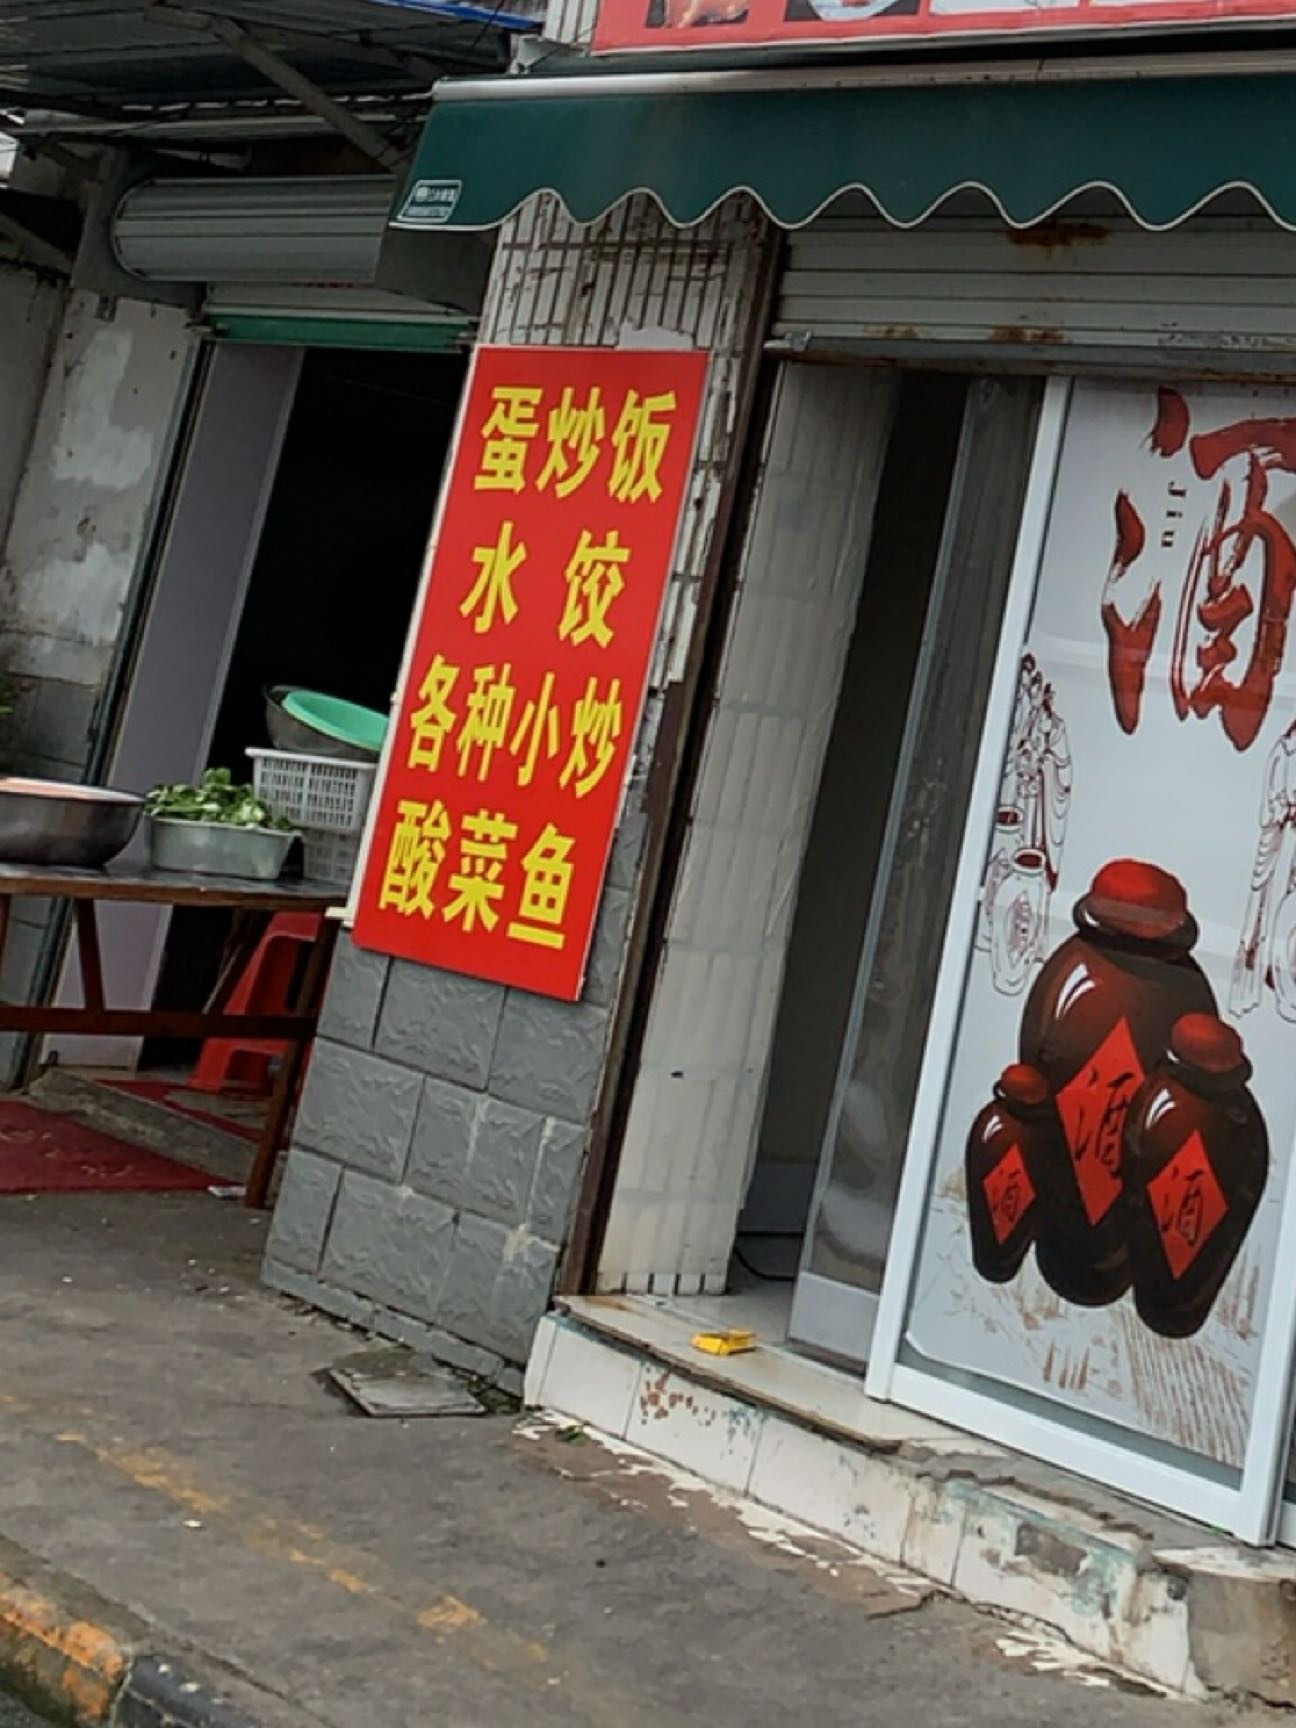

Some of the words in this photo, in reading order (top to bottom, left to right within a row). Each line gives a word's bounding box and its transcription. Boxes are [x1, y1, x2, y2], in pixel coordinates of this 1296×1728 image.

[472, 385, 678, 504] 蛋炒饭
[459, 521, 632, 649] 水饺
[408, 654, 623, 799] 各种小炒
[378, 798, 577, 951] 酸菜鱼
